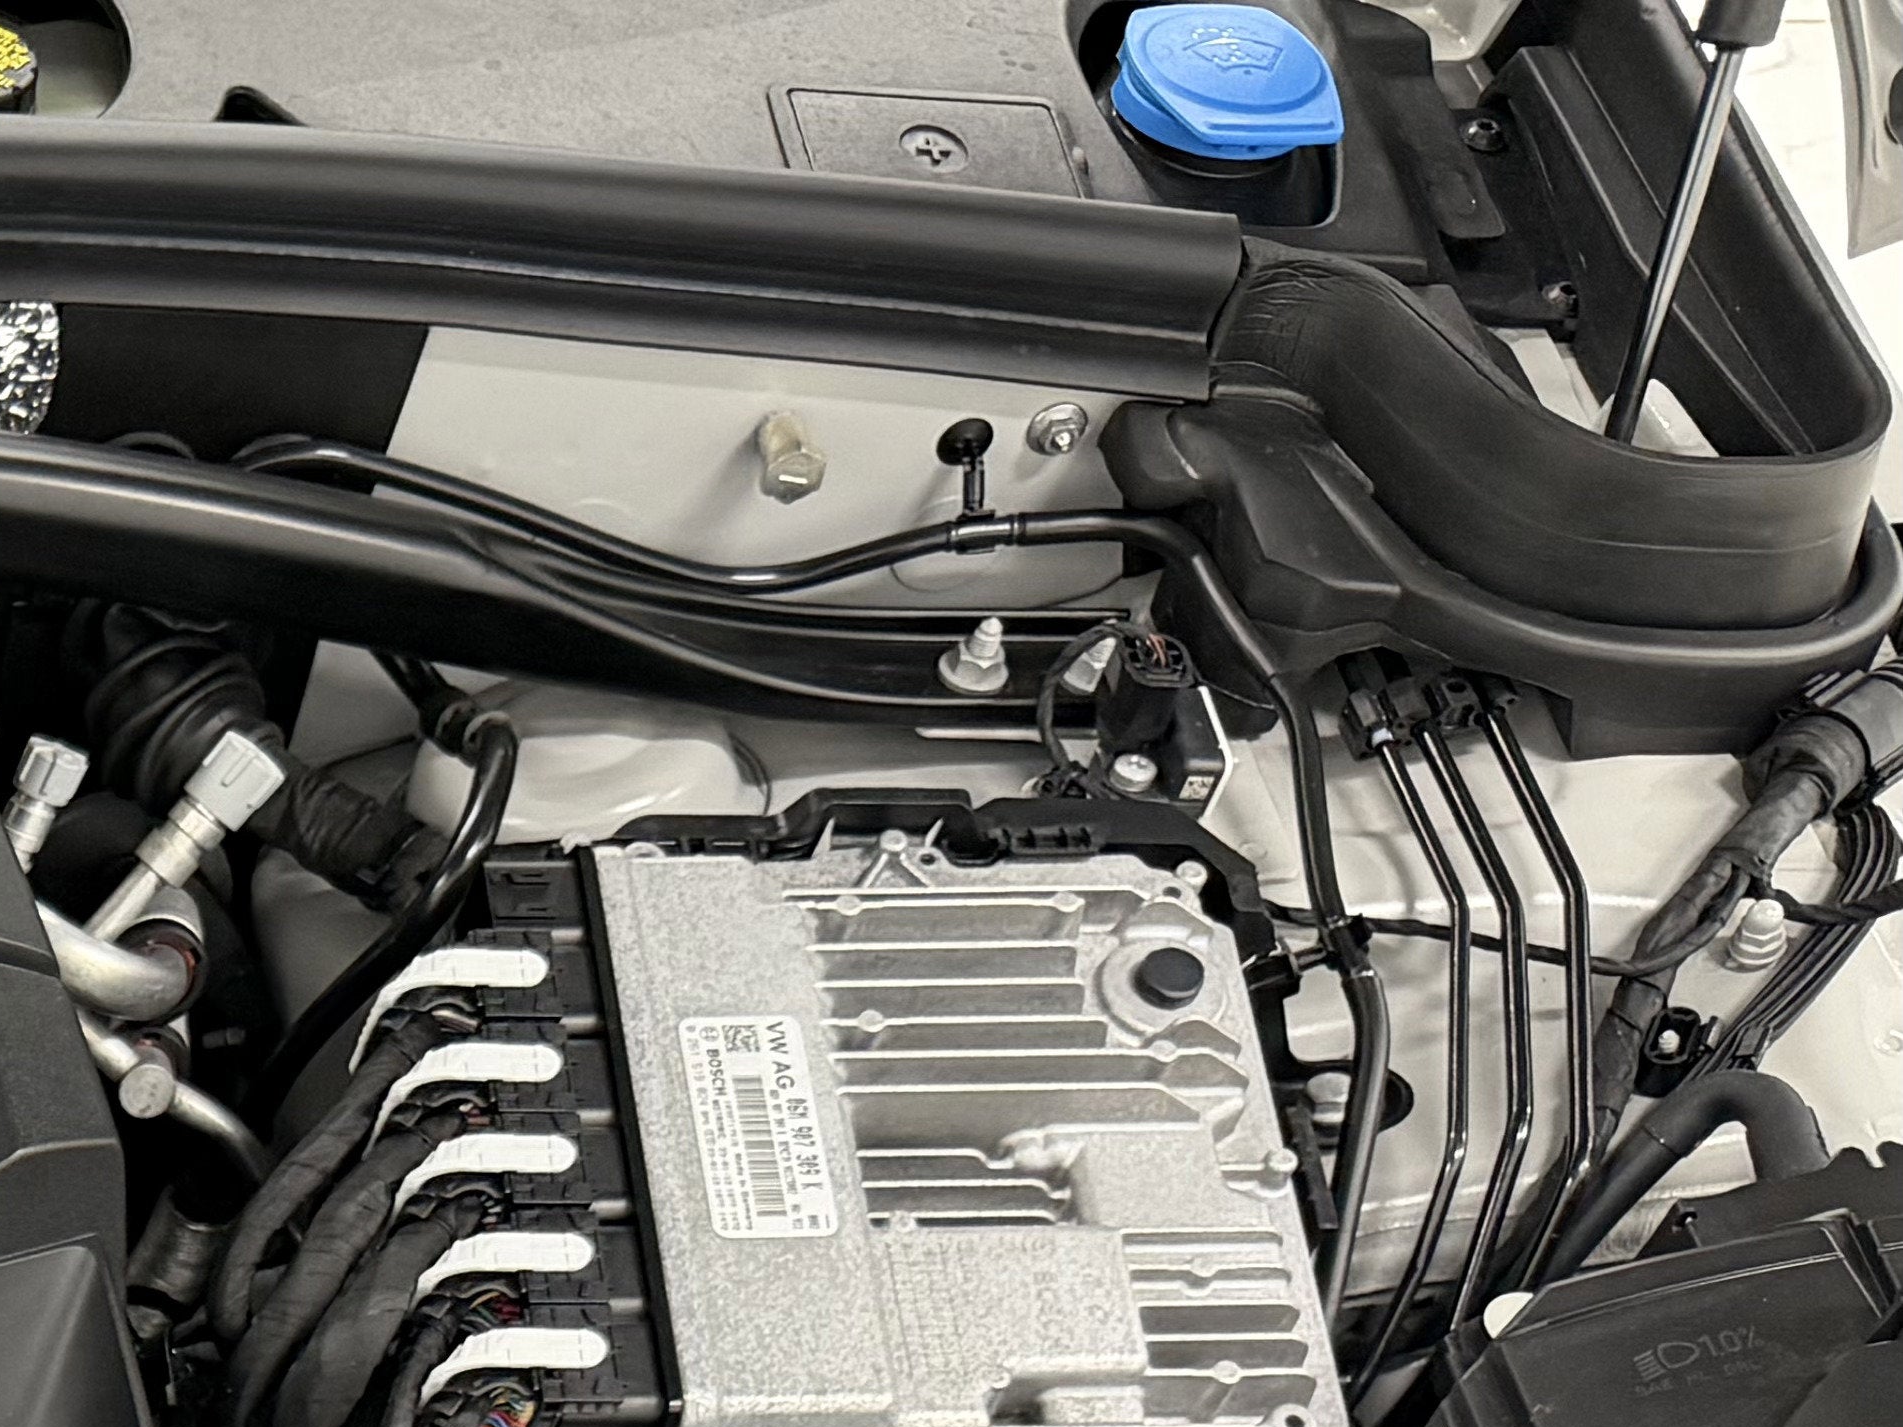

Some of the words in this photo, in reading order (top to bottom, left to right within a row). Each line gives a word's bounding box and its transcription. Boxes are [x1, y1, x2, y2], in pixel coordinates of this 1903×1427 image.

[766, 1021, 788, 1055] VW
[706, 1048, 726, 1096] BOSCH
[772, 1061, 794, 1090] AG
